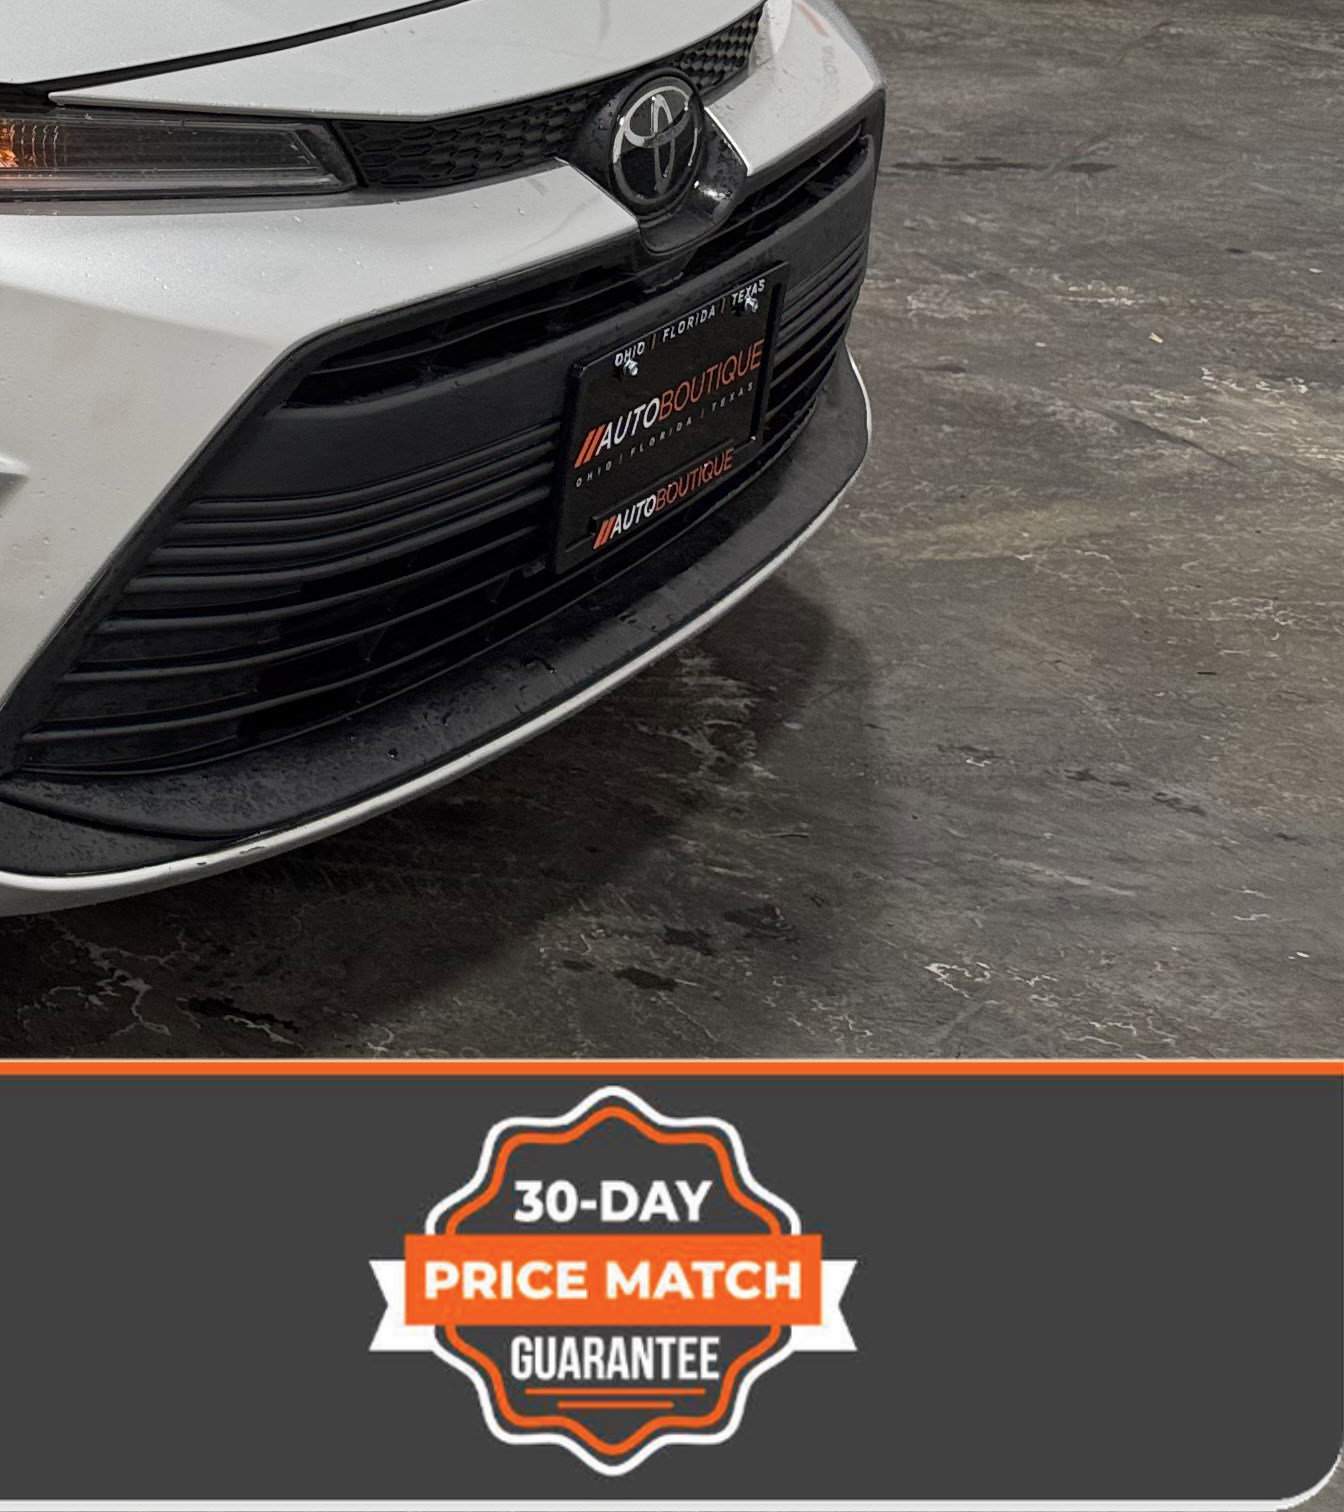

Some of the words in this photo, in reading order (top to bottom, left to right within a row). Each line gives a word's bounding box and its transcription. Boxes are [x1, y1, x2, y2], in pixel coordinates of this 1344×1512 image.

[614, 341, 646, 368] OHIO
[662, 304, 716, 343] FLORIDA
[731, 278, 766, 307] TEXAS
[575, 460, 613, 488] OHIO
[630, 416, 693, 458] FLORIDA
[711, 381, 754, 412] TEXAS
[594, 338, 765, 457] AUTOBOUTIQUE
[610, 446, 735, 540] AUTOBOUTIQUE
